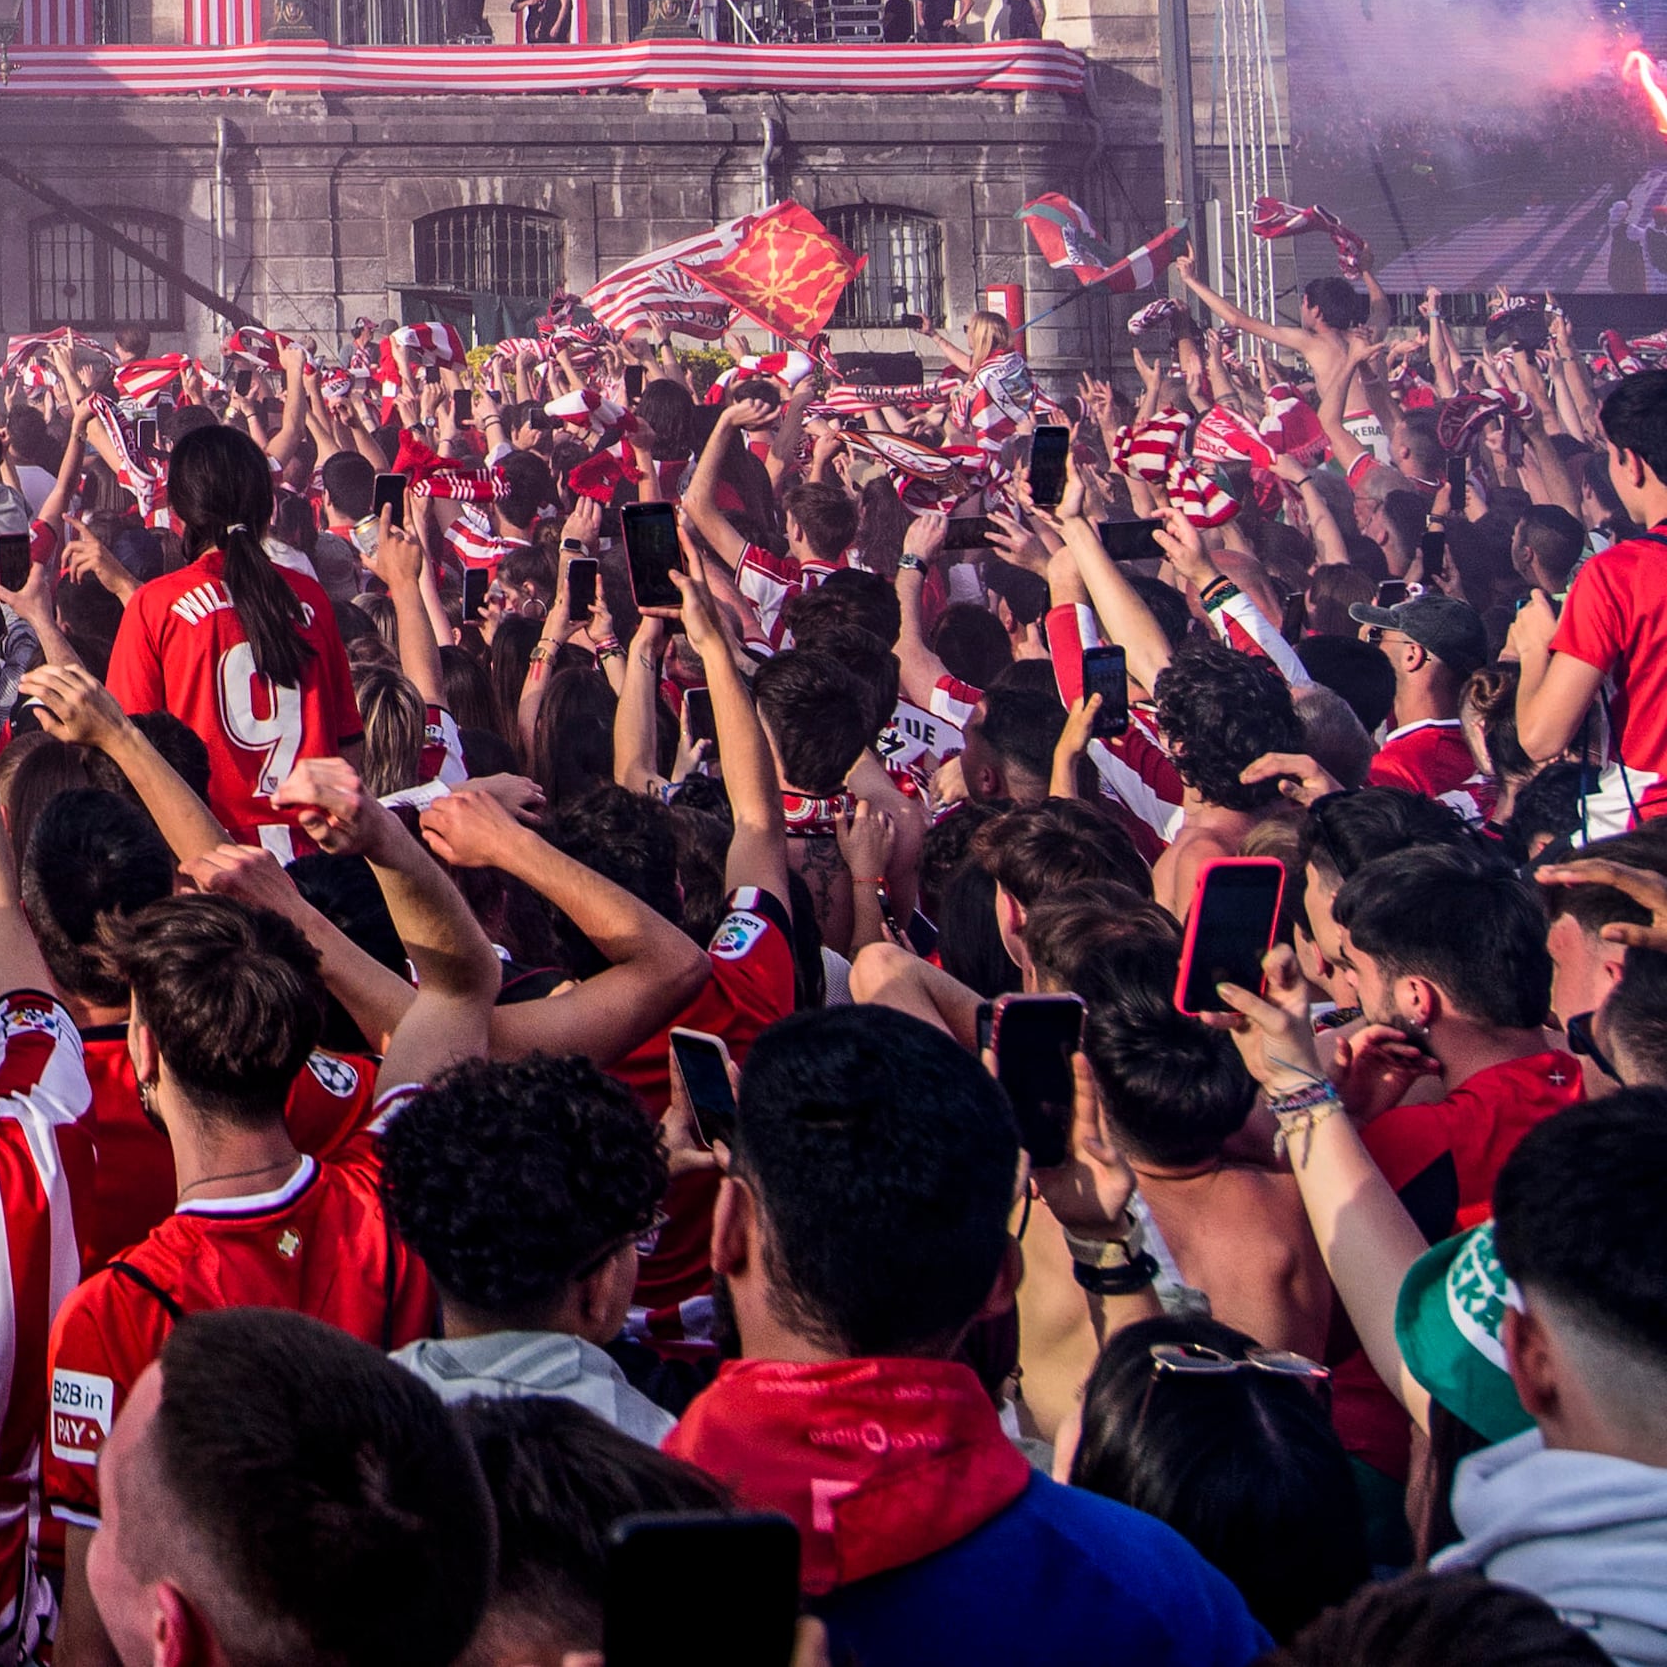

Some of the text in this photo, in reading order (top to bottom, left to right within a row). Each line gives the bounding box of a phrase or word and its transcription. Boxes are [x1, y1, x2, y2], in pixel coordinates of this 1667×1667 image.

[217, 641, 303, 798] 9
[53, 1379, 103, 1410] B2B in
[57, 1416, 87, 1445] PAY
